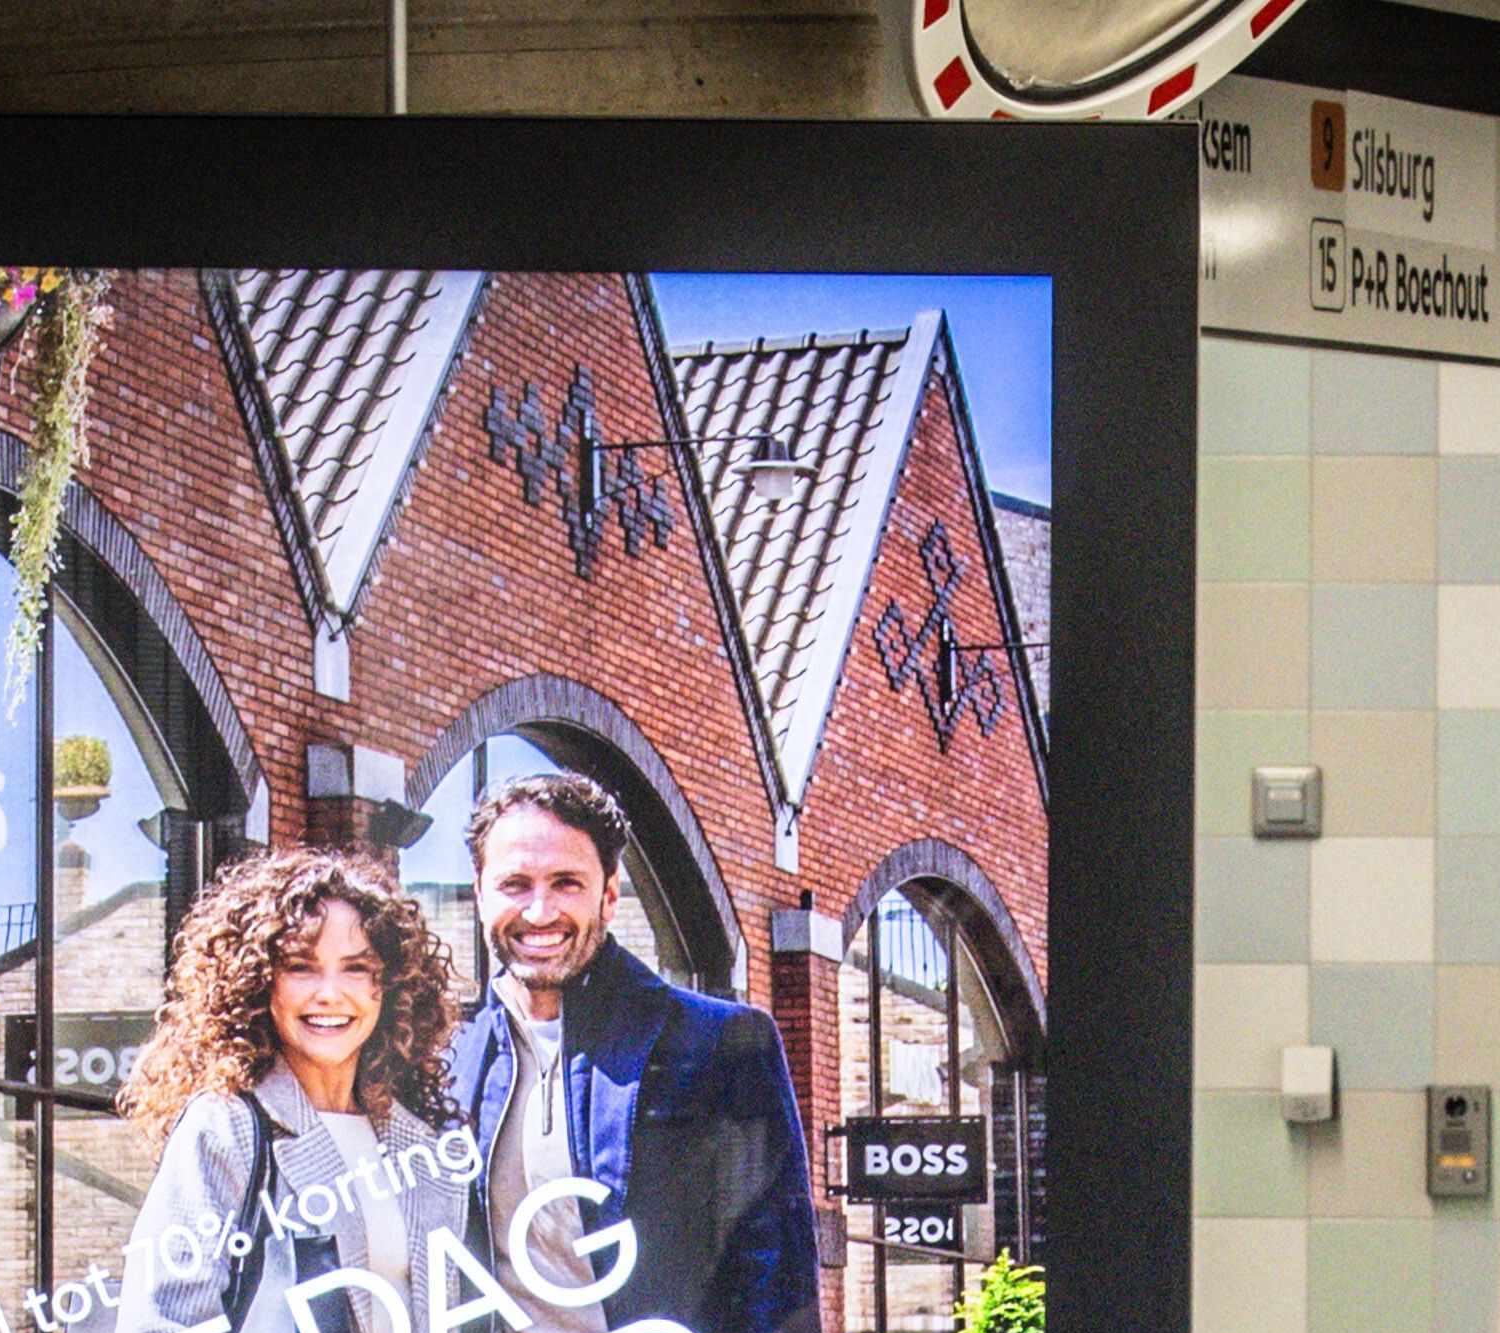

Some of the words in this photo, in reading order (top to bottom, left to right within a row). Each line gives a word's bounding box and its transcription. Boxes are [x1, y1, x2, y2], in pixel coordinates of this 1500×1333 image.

[1322, 117, 1334, 171] 9
[1352, 128, 1435, 222] Silsburg
[1319, 235, 1336, 292] 15
[1352, 247, 1389, 310] P+R
[1396, 253, 1490, 323] Boechout
[865, 1144, 968, 1175] BOSS
[23, 1263, 121, 1333] tot
[121, 1210, 252, 1293] 70%
[260, 1123, 483, 1240] korting
